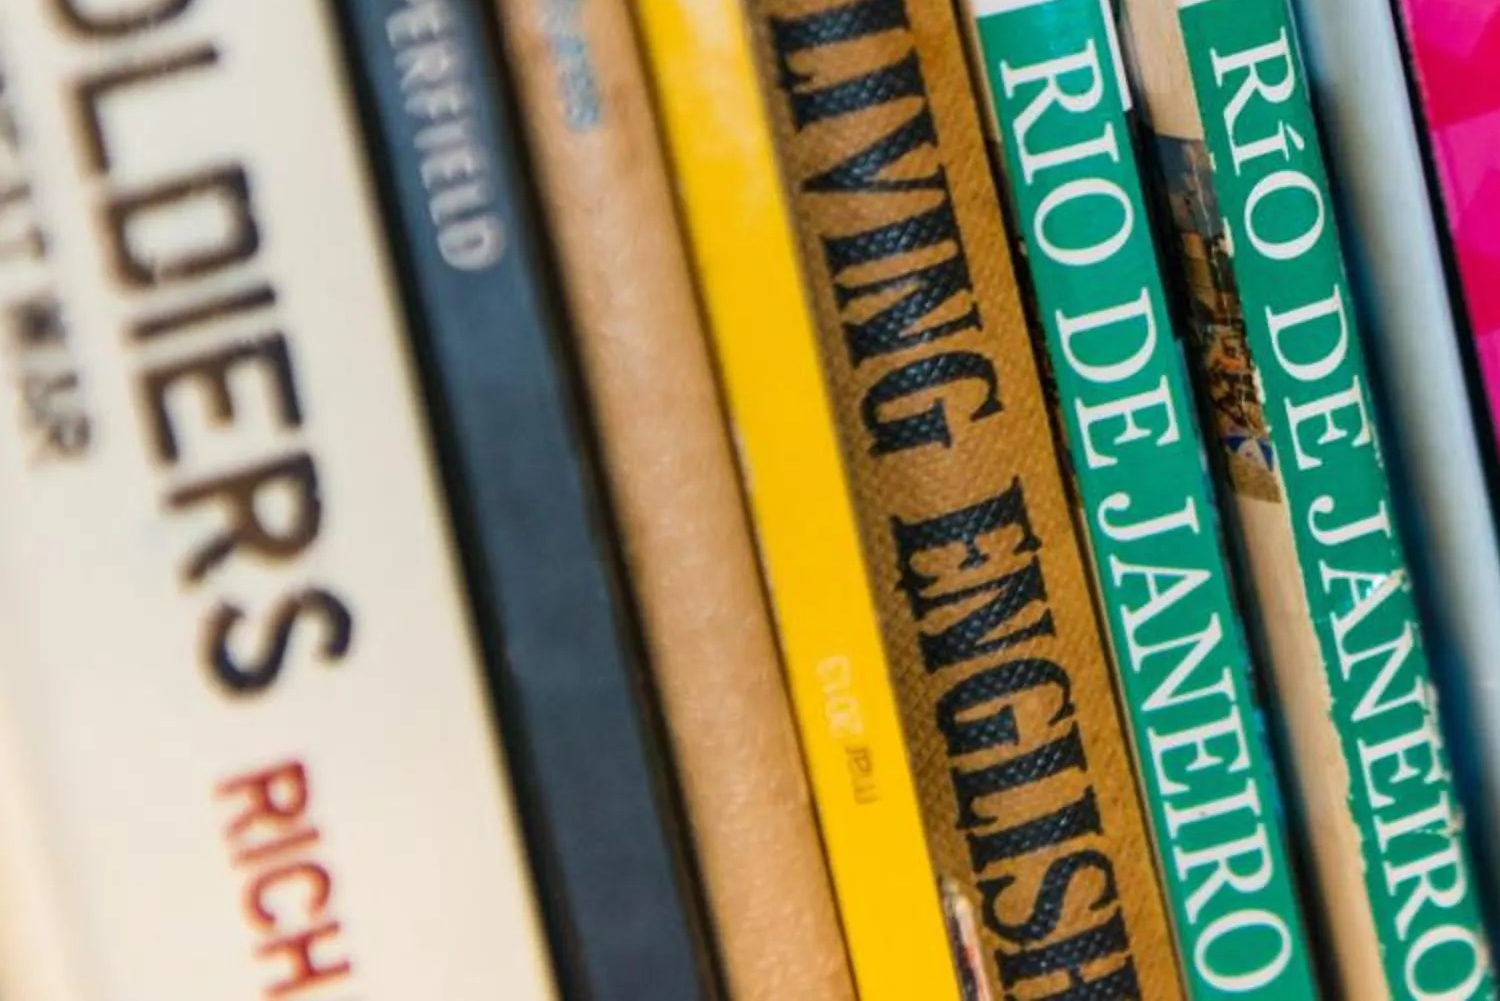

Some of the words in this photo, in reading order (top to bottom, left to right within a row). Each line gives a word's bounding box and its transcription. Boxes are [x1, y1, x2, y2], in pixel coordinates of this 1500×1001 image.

[1000, 38, 1134, 266] RIO
[1210, 26, 1325, 260] RÍO
[1055, 286, 1180, 469] DE
[1264, 285, 1370, 471] DE
[891, 476, 1144, 1001] ENGLISH
[1099, 493, 1292, 992] JANEIRO
[1307, 496, 1486, 1001] JANEIRO
